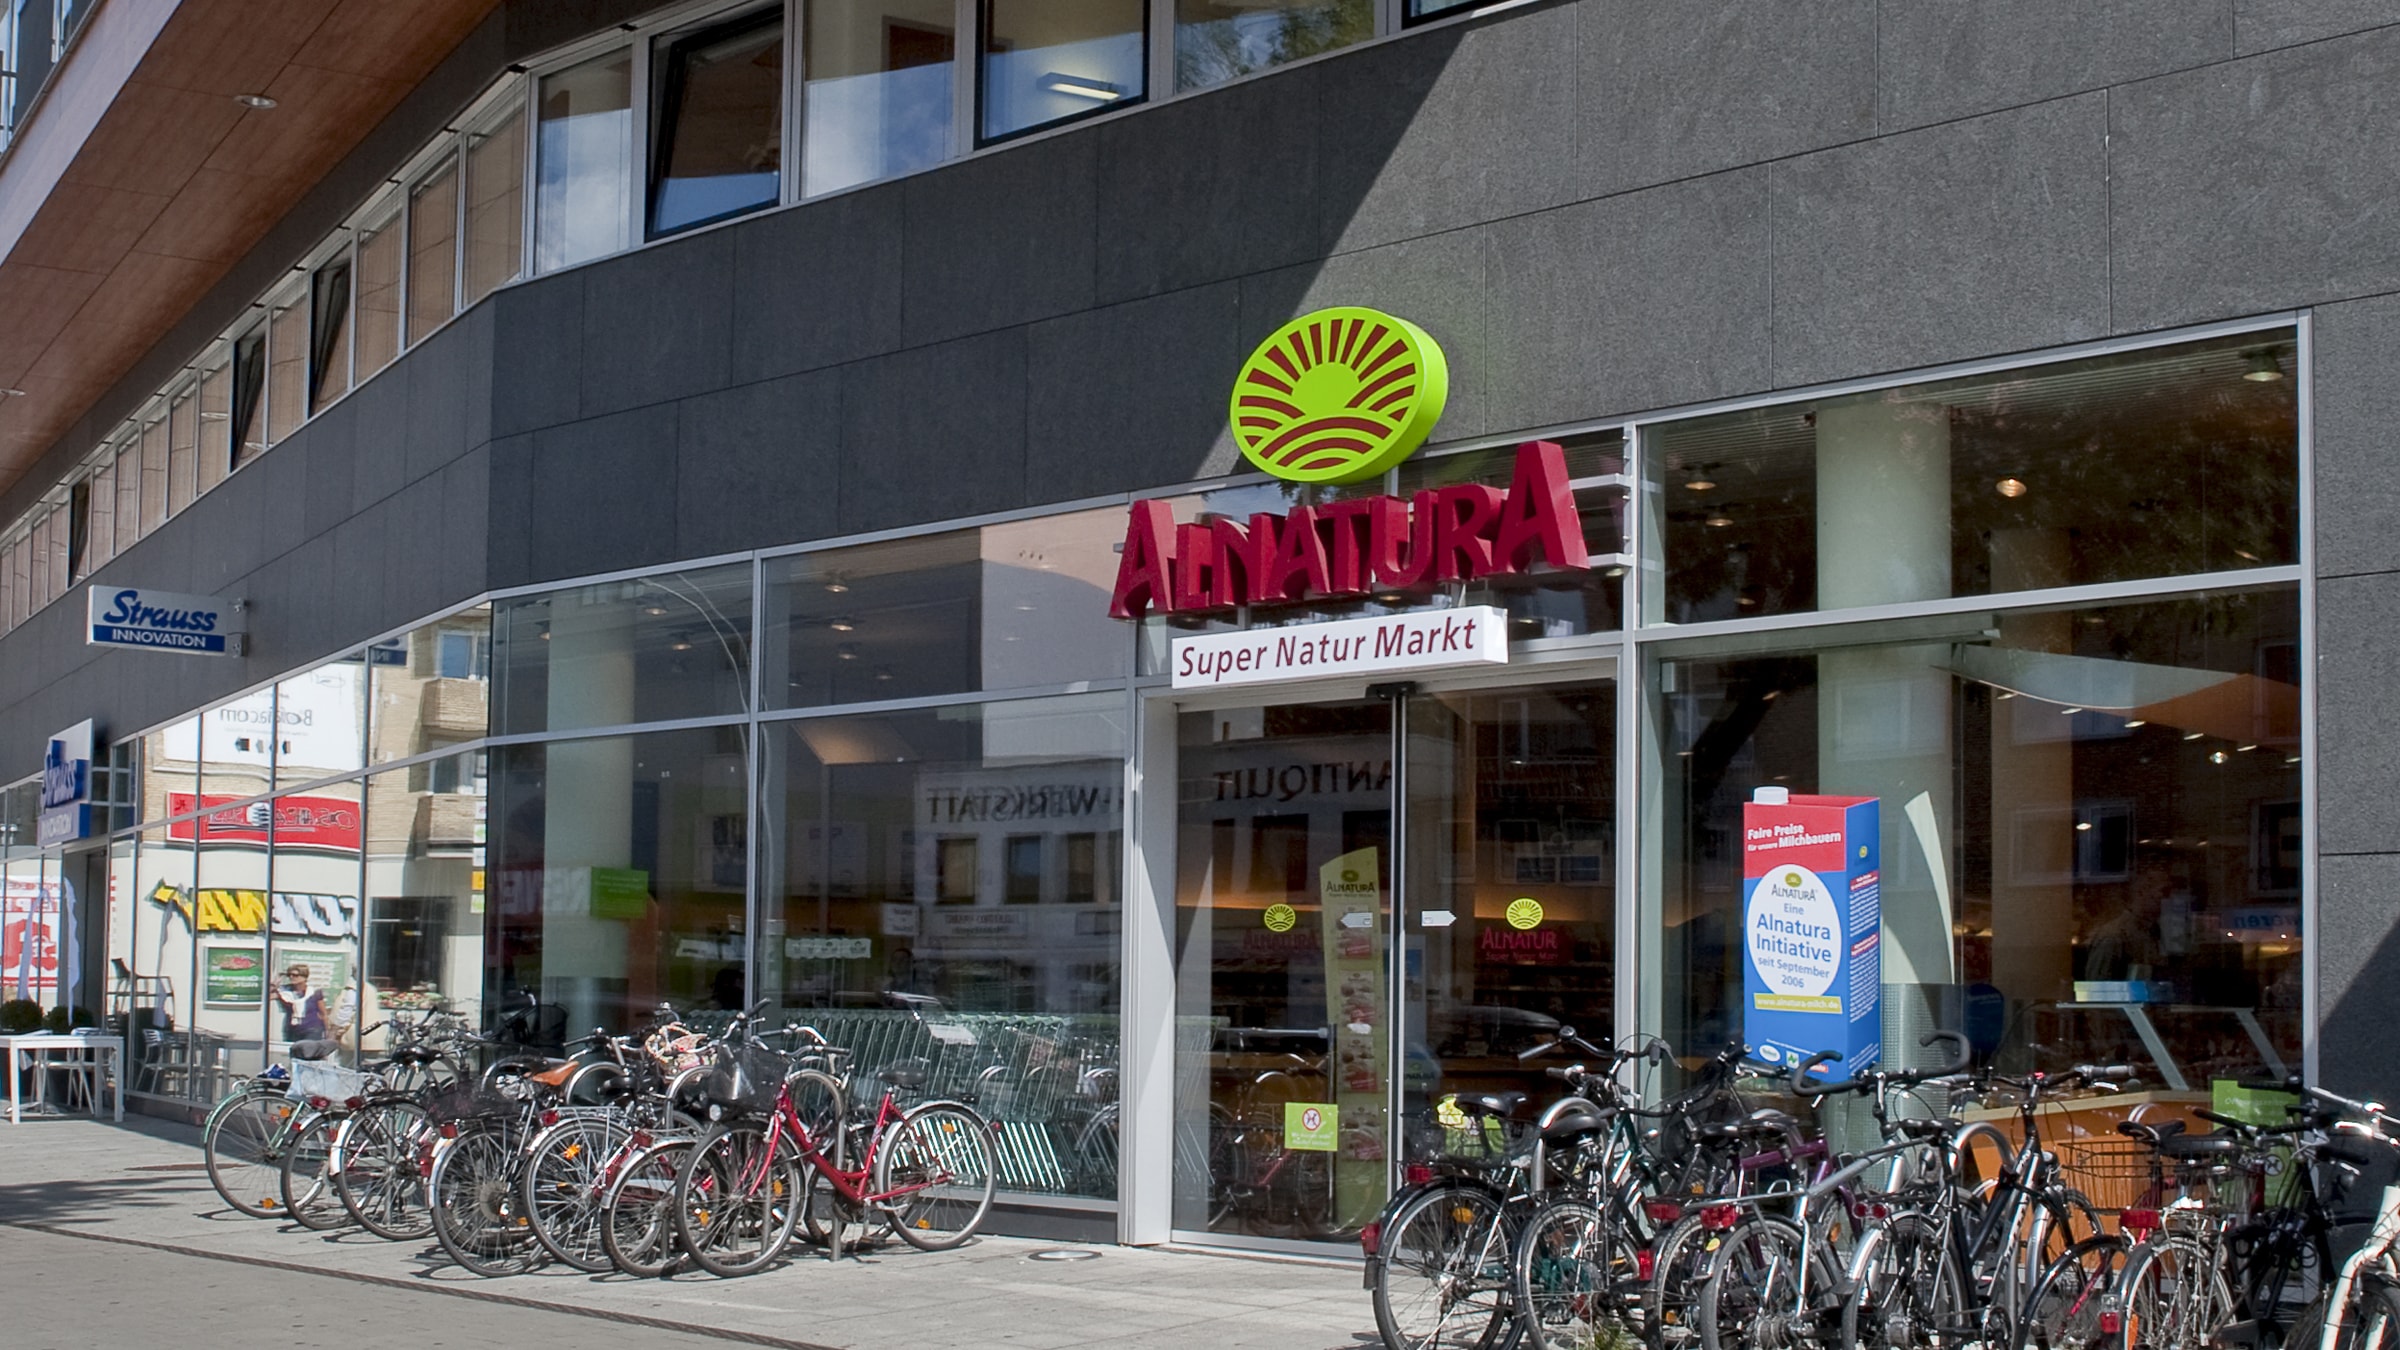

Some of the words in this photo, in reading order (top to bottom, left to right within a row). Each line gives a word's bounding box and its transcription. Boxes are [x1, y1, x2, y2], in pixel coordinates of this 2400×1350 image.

[1107, 440, 1591, 621] ALNATURA
[102, 589, 218, 632] Strauss
[112, 628, 207, 648] INNOVATION
[1179, 643, 1269, 682] Super
[1275, 631, 1367, 668] Natur
[1374, 615, 1477, 658] Markt
[1747, 827, 1772, 841] Faire
[1774, 823, 1804, 837] Preise
[1778, 831, 1842, 849] Milchbauern
[1783, 902, 1805, 916] Eine
[1756, 913, 1831, 940] Alnatura
[1756, 933, 1832, 962] Initiative
[1757, 956, 1775, 968] seit
[1776, 959, 1830, 979] September
[1781, 974, 1805, 988] 2006
